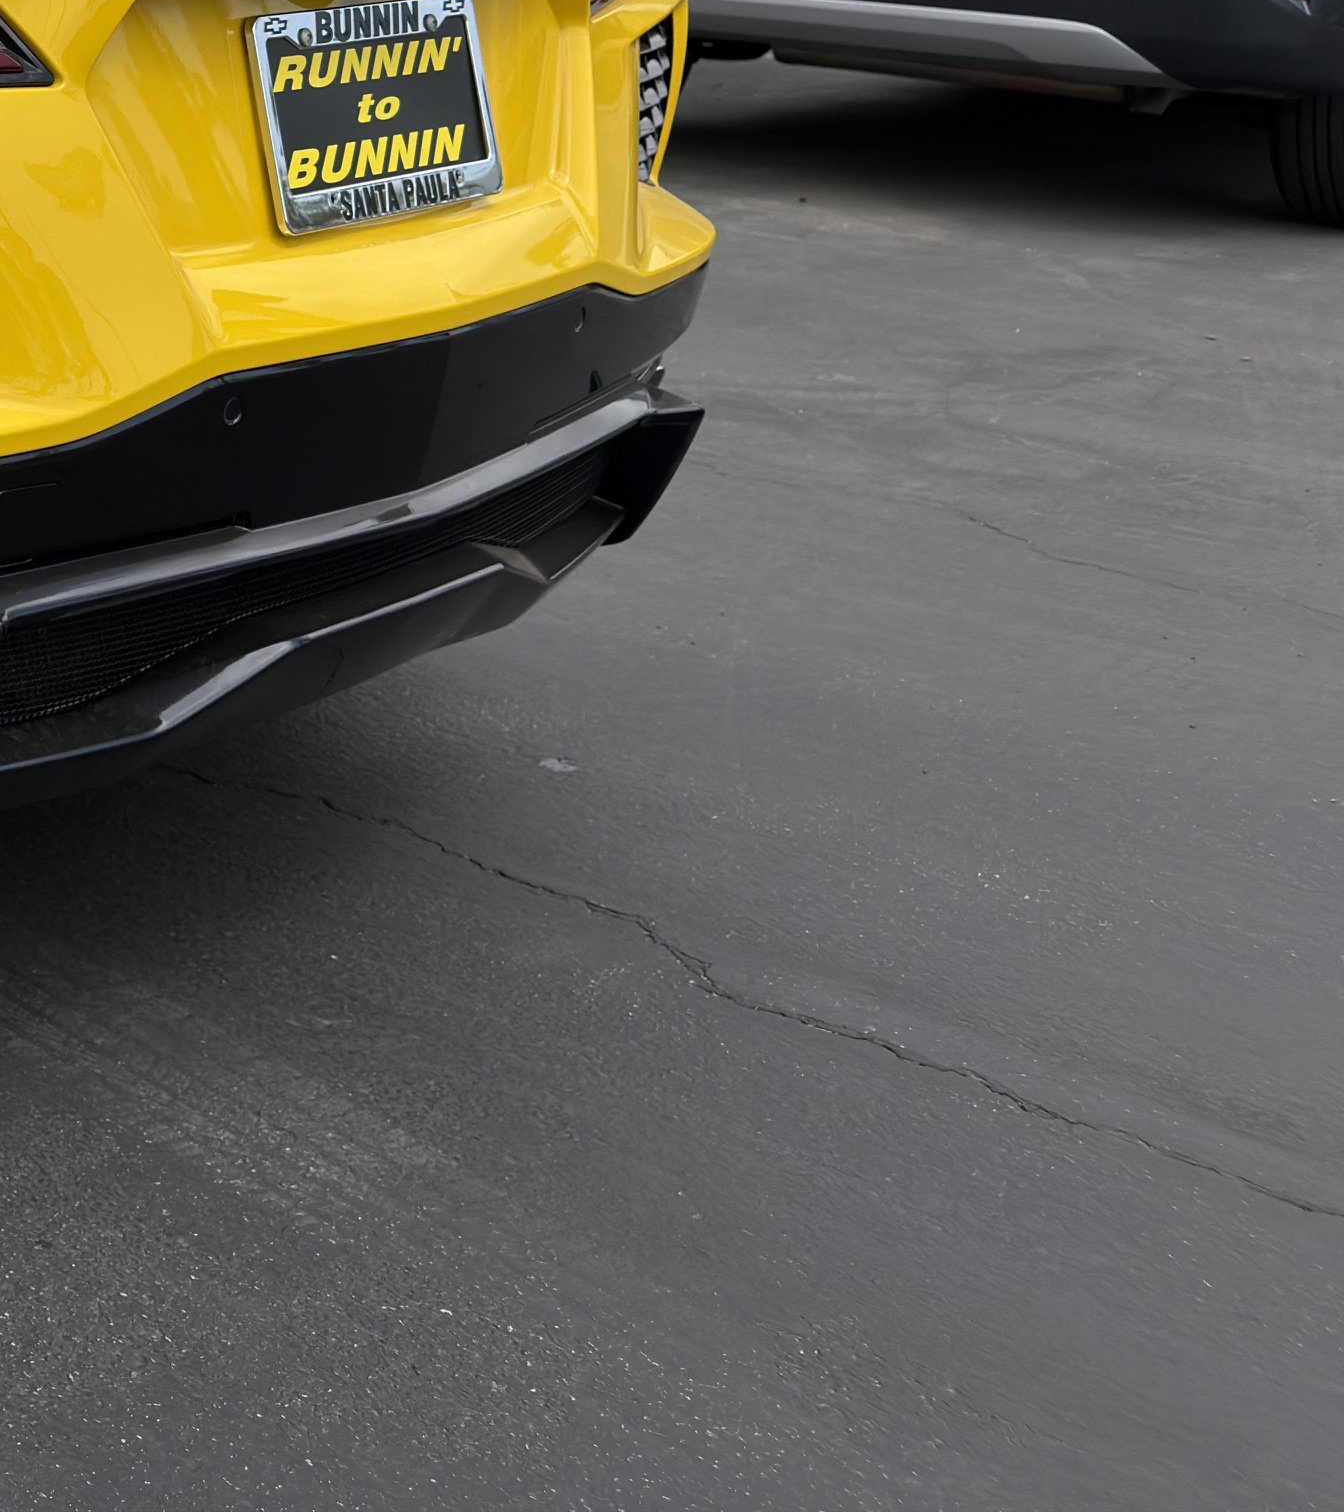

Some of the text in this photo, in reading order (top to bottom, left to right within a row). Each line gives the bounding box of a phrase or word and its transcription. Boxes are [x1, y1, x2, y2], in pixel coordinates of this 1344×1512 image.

[315, 0, 420, 45] BUNNIN
[273, 36, 462, 93] RUNNIN'
[357, 93, 401, 123] to
[288, 124, 465, 190] BUNNIN
